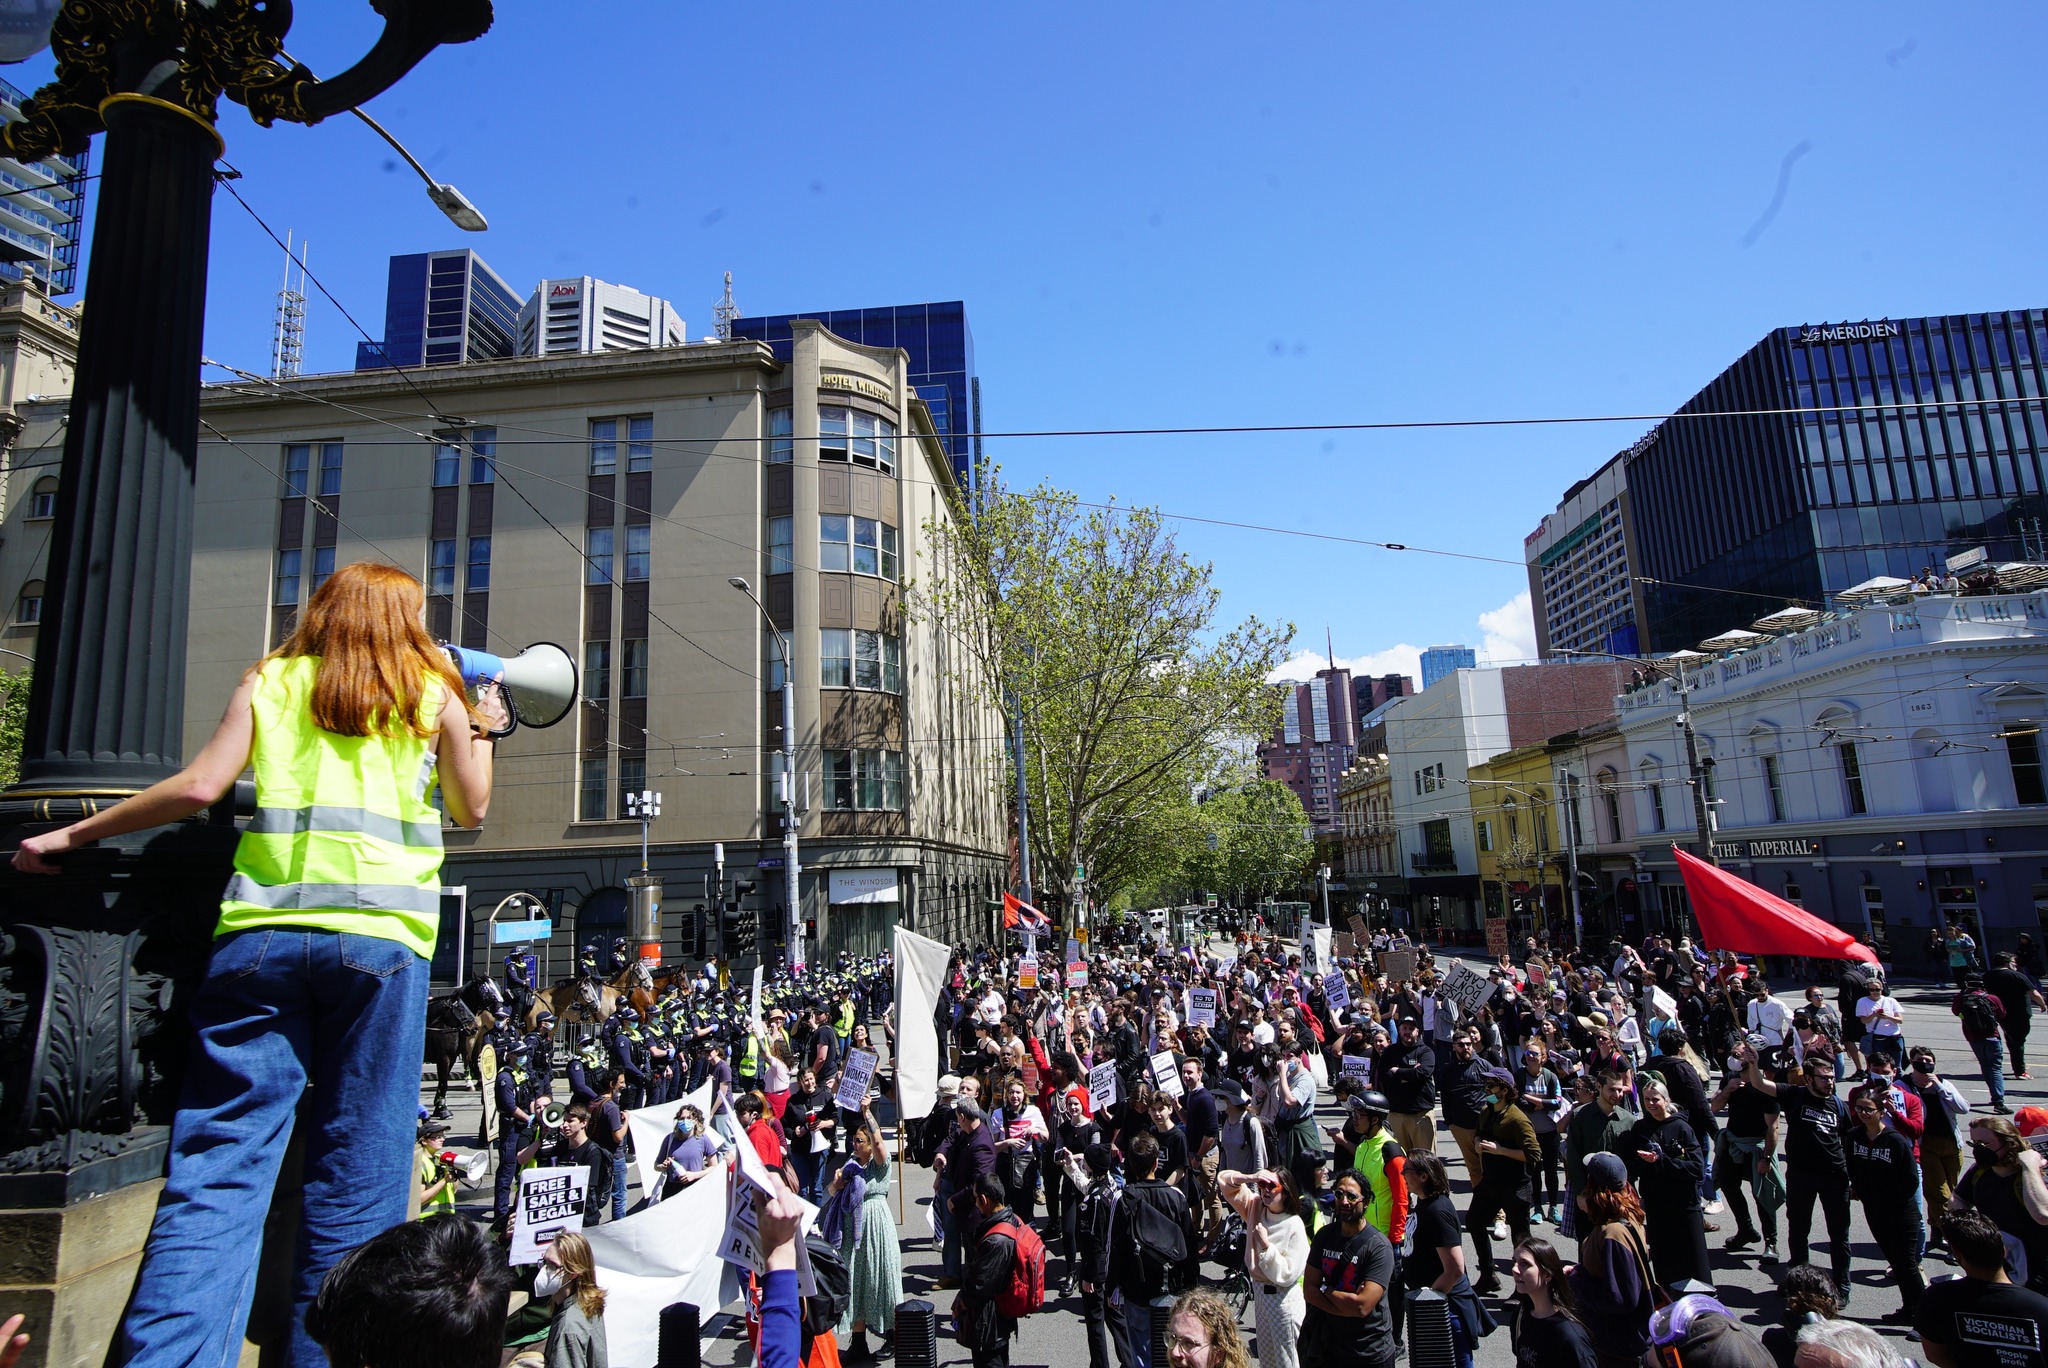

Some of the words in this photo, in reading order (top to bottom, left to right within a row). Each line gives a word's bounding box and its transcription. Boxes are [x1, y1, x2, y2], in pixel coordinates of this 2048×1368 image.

[1801, 327, 1820, 343] Le
[1822, 323, 1898, 342] MERIDIEN
[823, 373, 853, 389] HOTEL
[1630, 428, 1660, 461] MERIDIEN
[1911, 703, 1932, 712] 1863
[1715, 843, 1740, 858] THE
[1750, 839, 1812, 857] IMPERIAL
[839, 879, 856, 887] THE
[859, 878, 893, 887] WINDSOR
[1450, 977, 1482, 1000] DON'T
[1457, 967, 1487, 991] CARE
[845, 1066, 870, 1085] WOMEN
[1092, 1075, 1102, 1083] FOR
[840, 1086, 852, 1098] THEIR
[852, 1091, 863, 1102] FATE
[850, 1082, 866, 1093] DECIDE
[529, 1177, 566, 1195] FREE
[529, 1189, 566, 1209] SAFE
[568, 1189, 580, 1201] &
[529, 1203, 577, 1224] LEGAL
[1964, 1317, 2025, 1336] VICTORIAN
[1965, 1325, 2031, 1344] SOCIALISTS
[1996, 1348, 2029, 1360] people
[2001, 1357, 2026, 1367] profit
